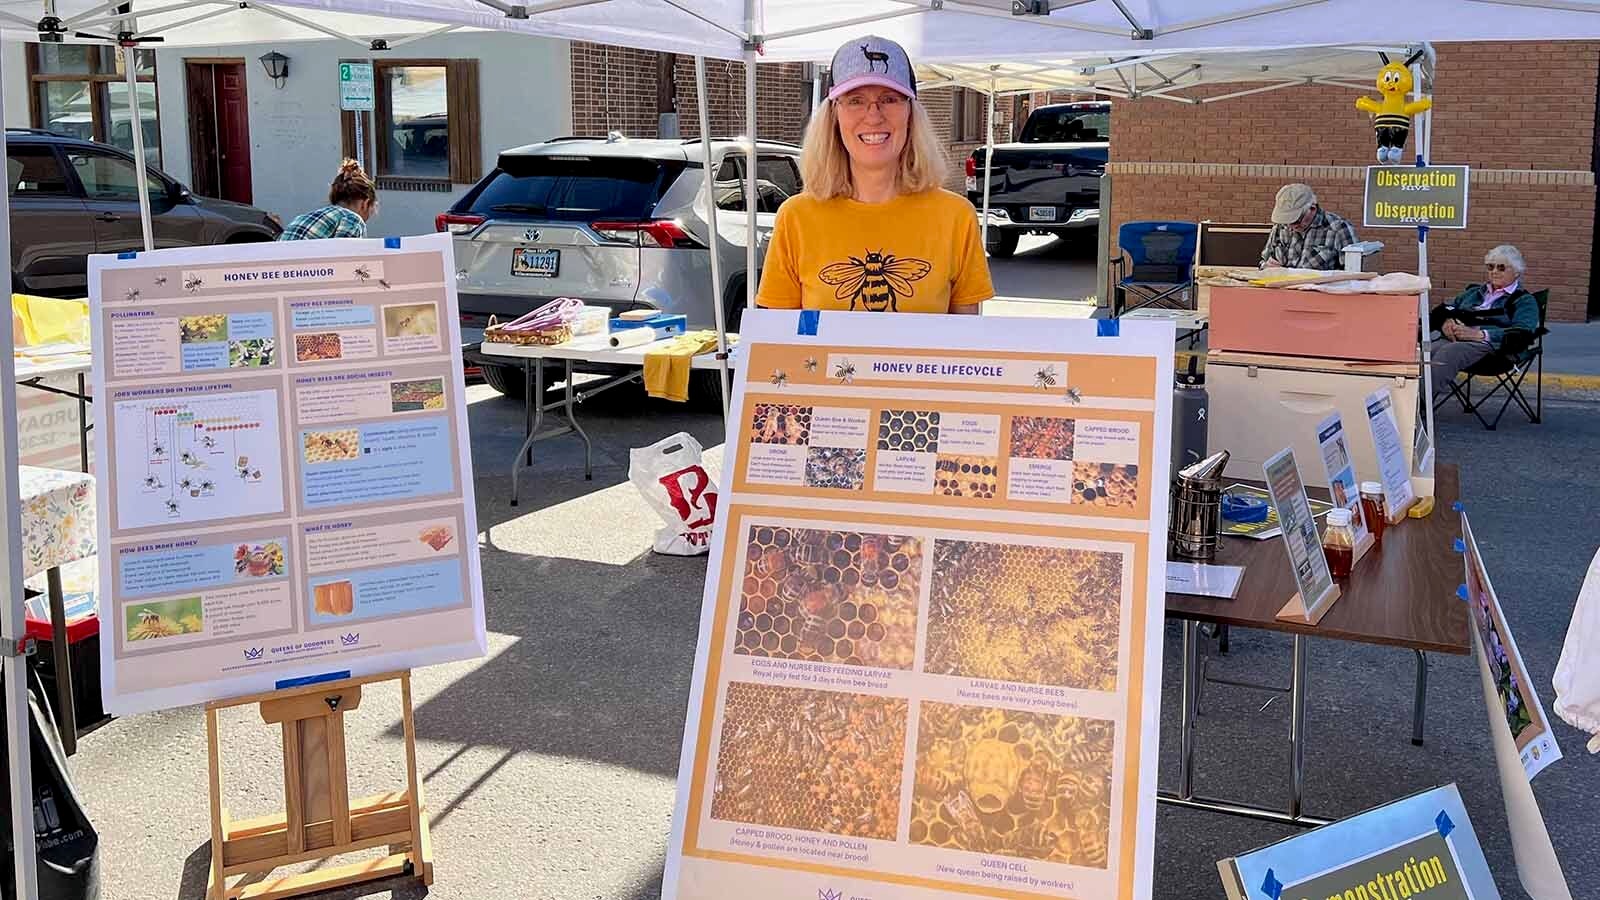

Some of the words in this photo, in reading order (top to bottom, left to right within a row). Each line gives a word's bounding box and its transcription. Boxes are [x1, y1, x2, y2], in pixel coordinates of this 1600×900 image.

[1376, 170, 1456, 187] Observation
[1375, 202, 1455, 219] Observation
[530, 256, 555, 270] 11291
[224, 272, 259, 282] HONEY
[262, 270, 281, 280] BEE
[283, 268, 334, 279] BEHAVIOR
[872, 362, 913, 375] HONEY
[915, 364, 938, 376] BEE
[940, 364, 1003, 378] LIFECYCLE
[752, 658, 772, 668] EGGS
[772, 661, 788, 670] AND
[788, 663, 813, 672] NURSE
[814, 665, 831, 673] BEES
[832, 666, 863, 677] FEEDING
[864, 670, 892, 679] LARVAE
[753, 670, 772, 679] Royal
[772, 671, 788, 681] jelly
[788, 672, 800, 680] fed
[801, 674, 810, 682] for
[818, 676, 835, 685] days
[836, 676, 851, 685] then
[853, 678, 866, 687] bee
[970, 680, 1000, 690] LARVAE
[1001, 683, 1017, 692] AND
[1018, 685, 1044, 695] NURSE
[1045, 687, 1065, 697] BEES
[1032, 698, 1055, 709] young
[735, 827, 765, 838] CAPPED
[766, 830, 794, 842] BROOD,
[795, 834, 821, 844] HONEY
[822, 838, 838, 848] AND
[839, 840, 868, 851] POLLEN
[730, 837, 755, 850] (Honey
[756, 840, 762, 849] &
[763, 840, 785, 852] pollen
[786, 844, 798, 853] are
[800, 844, 826, 857] located
[827, 849, 843, 858] near
[844, 850, 869, 863] brood)
[980, 859, 1007, 870] QUEEN
[1008, 862, 1028, 873] CELL
[956, 868, 980, 878] queen
[981, 868, 1003, 881] being
[1004, 872, 1028, 884] raised
[1029, 874, 1039, 887] by
[1040, 878, 1074, 890] workers)
